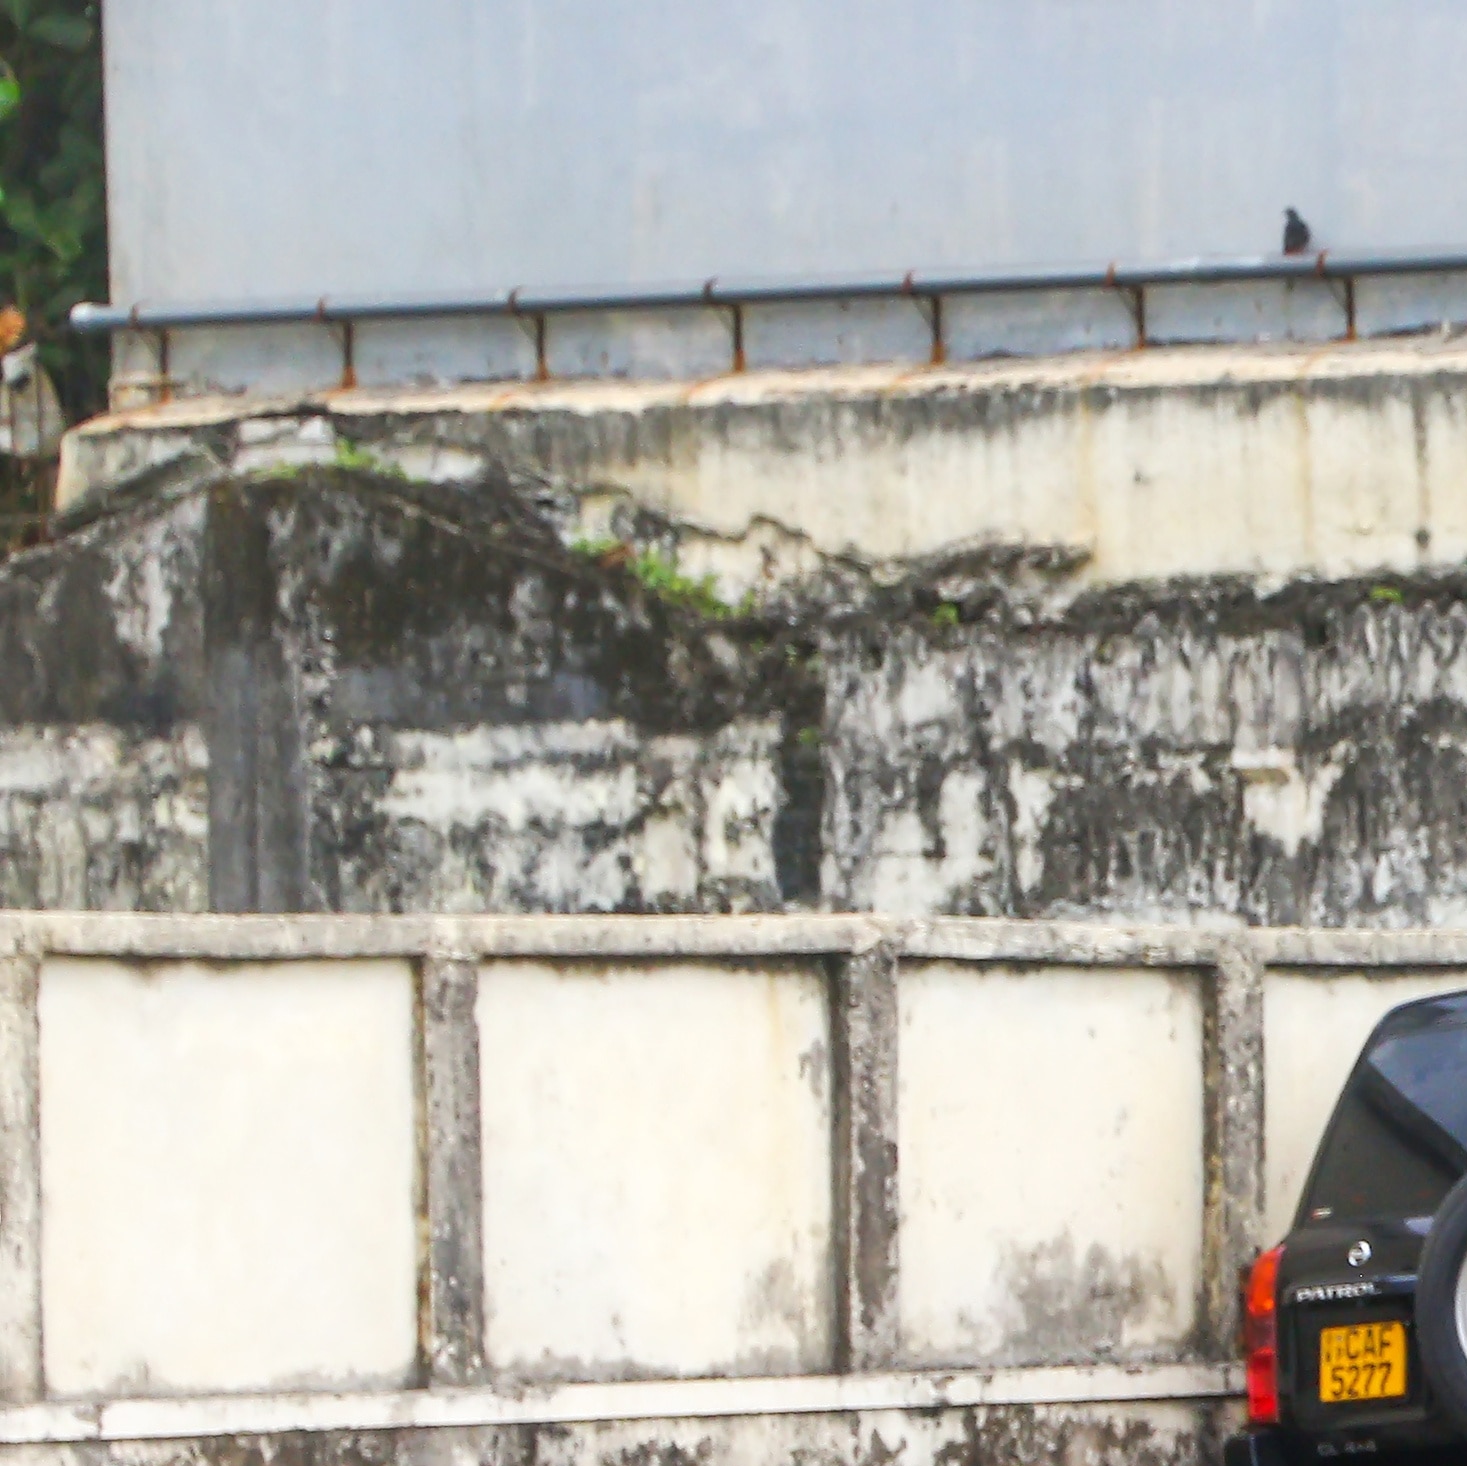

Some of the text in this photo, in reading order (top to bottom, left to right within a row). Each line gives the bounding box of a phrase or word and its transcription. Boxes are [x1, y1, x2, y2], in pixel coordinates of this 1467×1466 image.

[1296, 1282, 1382, 1302] PATROL
[1346, 1323, 1393, 1359] CAF
[1331, 1362, 1392, 1398] 5277
